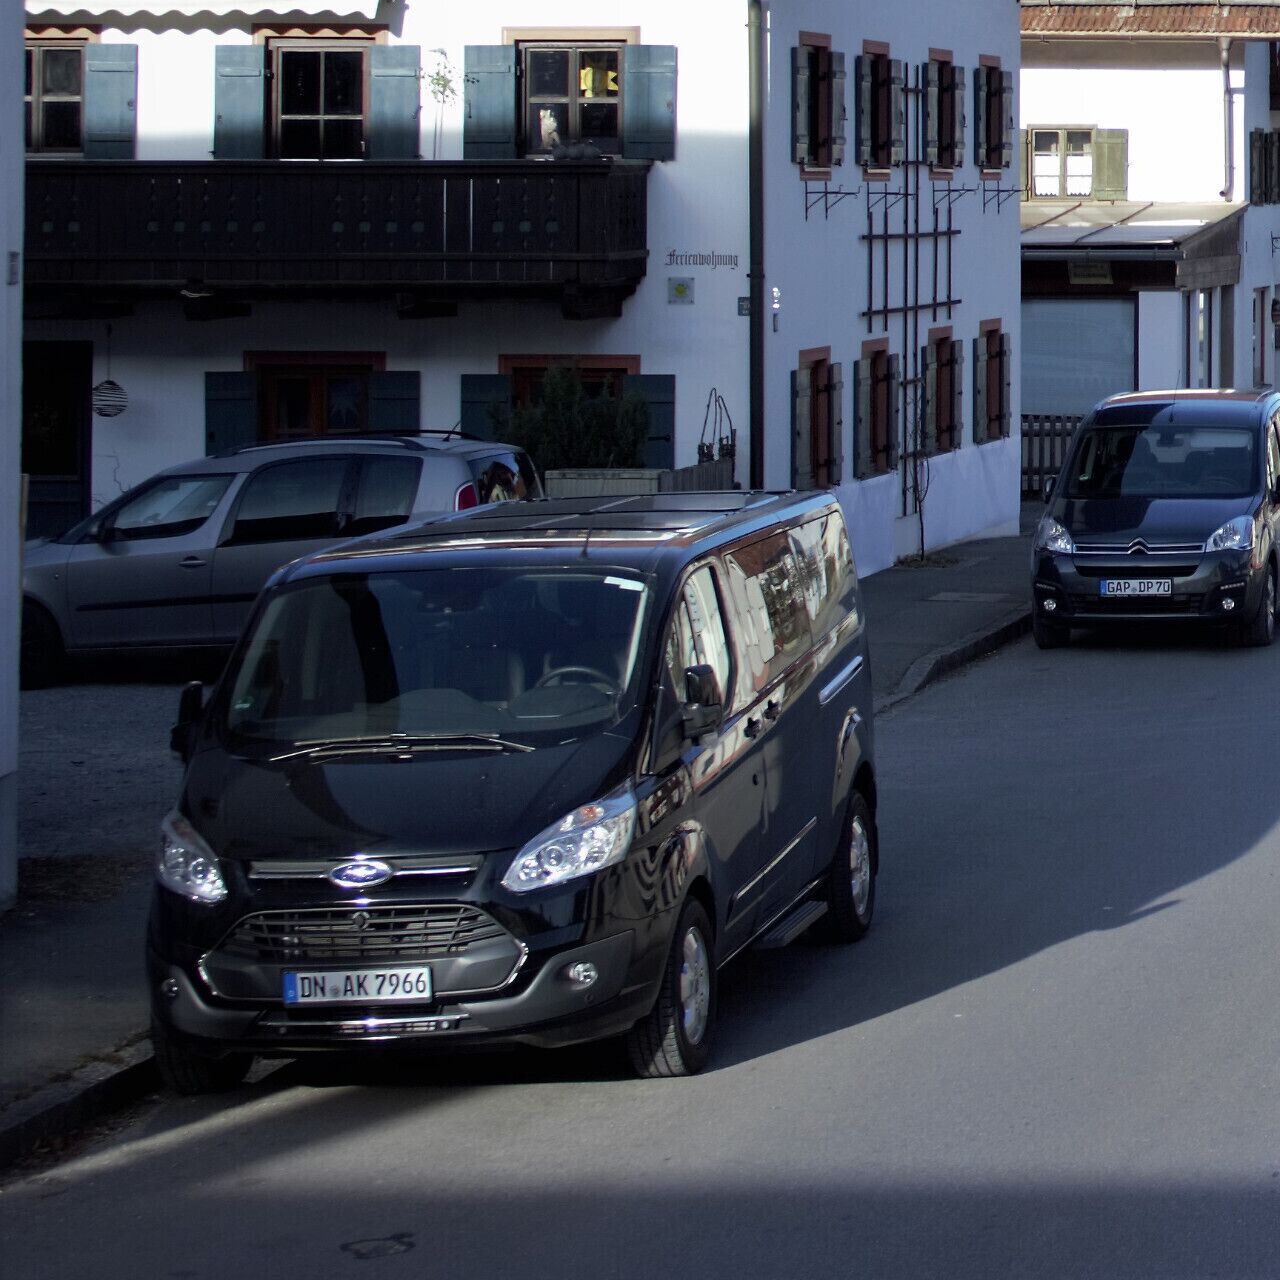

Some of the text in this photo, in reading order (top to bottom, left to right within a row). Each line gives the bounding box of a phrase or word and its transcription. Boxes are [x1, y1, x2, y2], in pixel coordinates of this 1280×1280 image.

[664, 249, 739, 270] Ferienwohnung
[1107, 581, 1170, 592] GAP DP 70
[300, 972, 426, 998] DN AK 7966
